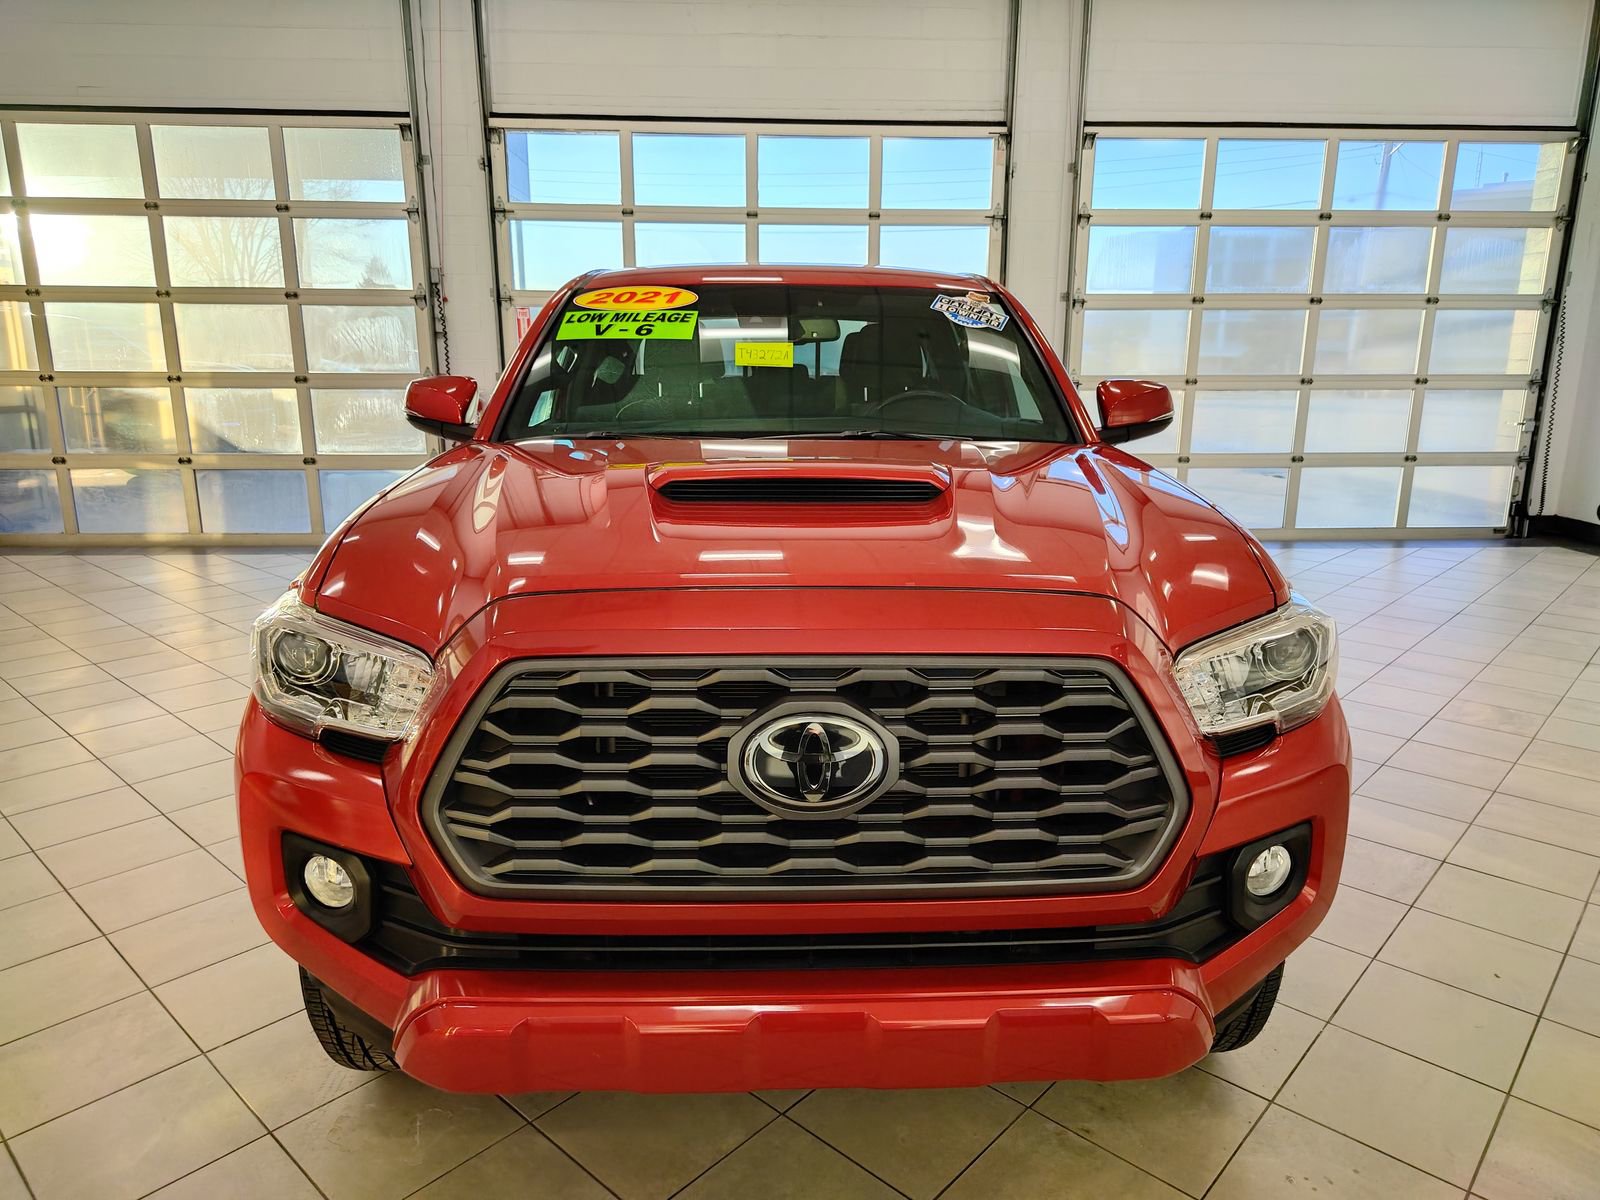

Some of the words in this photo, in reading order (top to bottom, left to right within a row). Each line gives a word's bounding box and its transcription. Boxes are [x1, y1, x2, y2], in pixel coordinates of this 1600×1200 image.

[586, 291, 682, 304] 2021
[565, 312, 609, 324] LOW
[609, 312, 694, 323] MILEAGE
[941, 298, 1001, 321] CARFAX
[947, 306, 999, 327] OWNER
